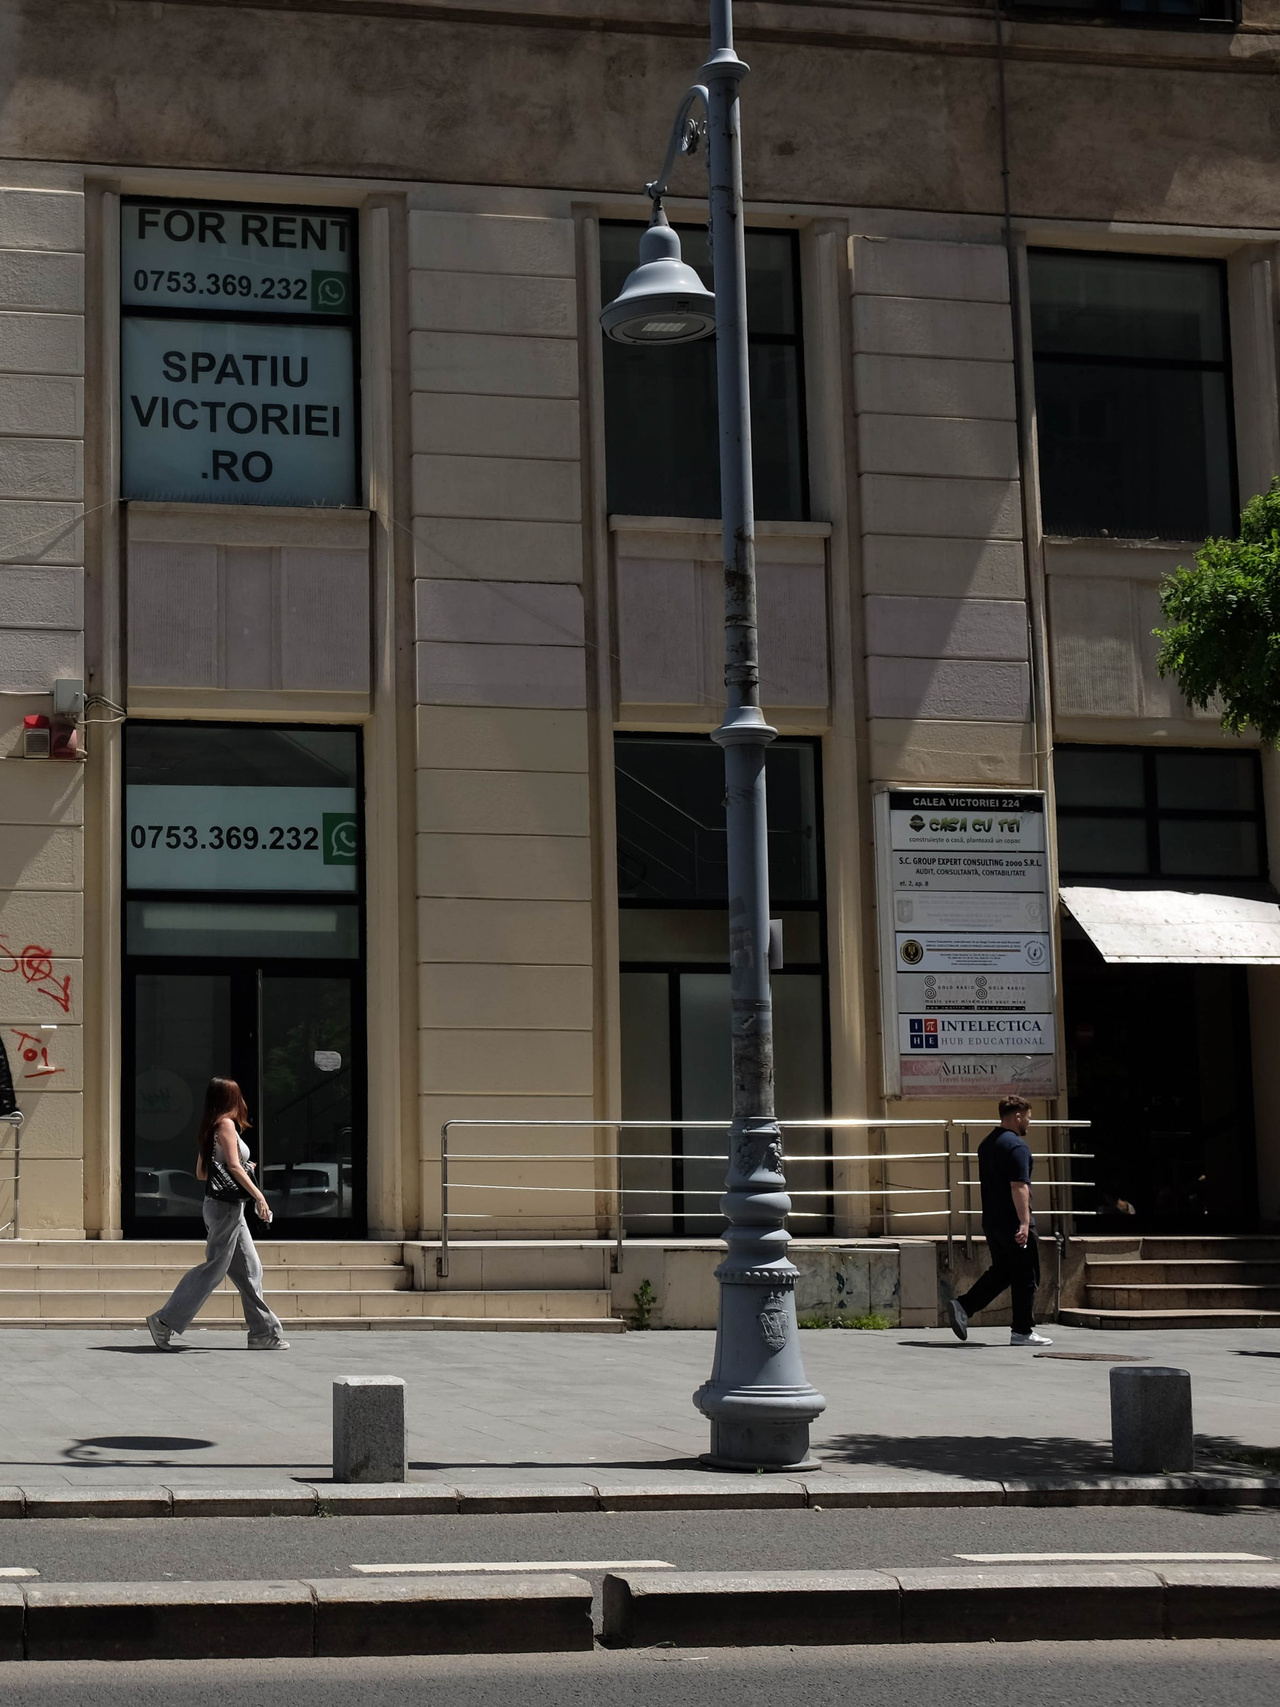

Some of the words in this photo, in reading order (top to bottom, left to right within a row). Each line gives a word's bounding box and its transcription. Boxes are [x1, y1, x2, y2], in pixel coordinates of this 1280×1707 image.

[137, 208, 227, 244] FOR
[240, 213, 349, 253] RENT
[133, 269, 309, 301] 0753.369.232
[161, 350, 309, 388] SPATIU
[129, 394, 341, 438] VICTORIEI
[200, 448, 274, 484] .RO
[912, 797, 947, 807] CALEA
[947, 797, 1000, 808] VICTORIEI
[1001, 799, 1021, 808] 224
[928, 817, 968, 833] CASA
[971, 818, 994, 833] CU
[997, 819, 1021, 834] TEI
[130, 825, 319, 851] 0753.369.232
[898, 857, 912, 865] S.C.
[912, 857, 937, 865] GROUP
[937, 858, 962, 866] EXPERT
[962, 858, 1004, 867] CONSULTING
[1005, 859, 1023, 867] 2000
[1023, 859, 1043, 868] S.R.L.
[940, 1020, 1042, 1032] INTELECTICA
[941, 1037, 964, 1045] HUB
[940, 1061, 998, 1076] AMBIENT
